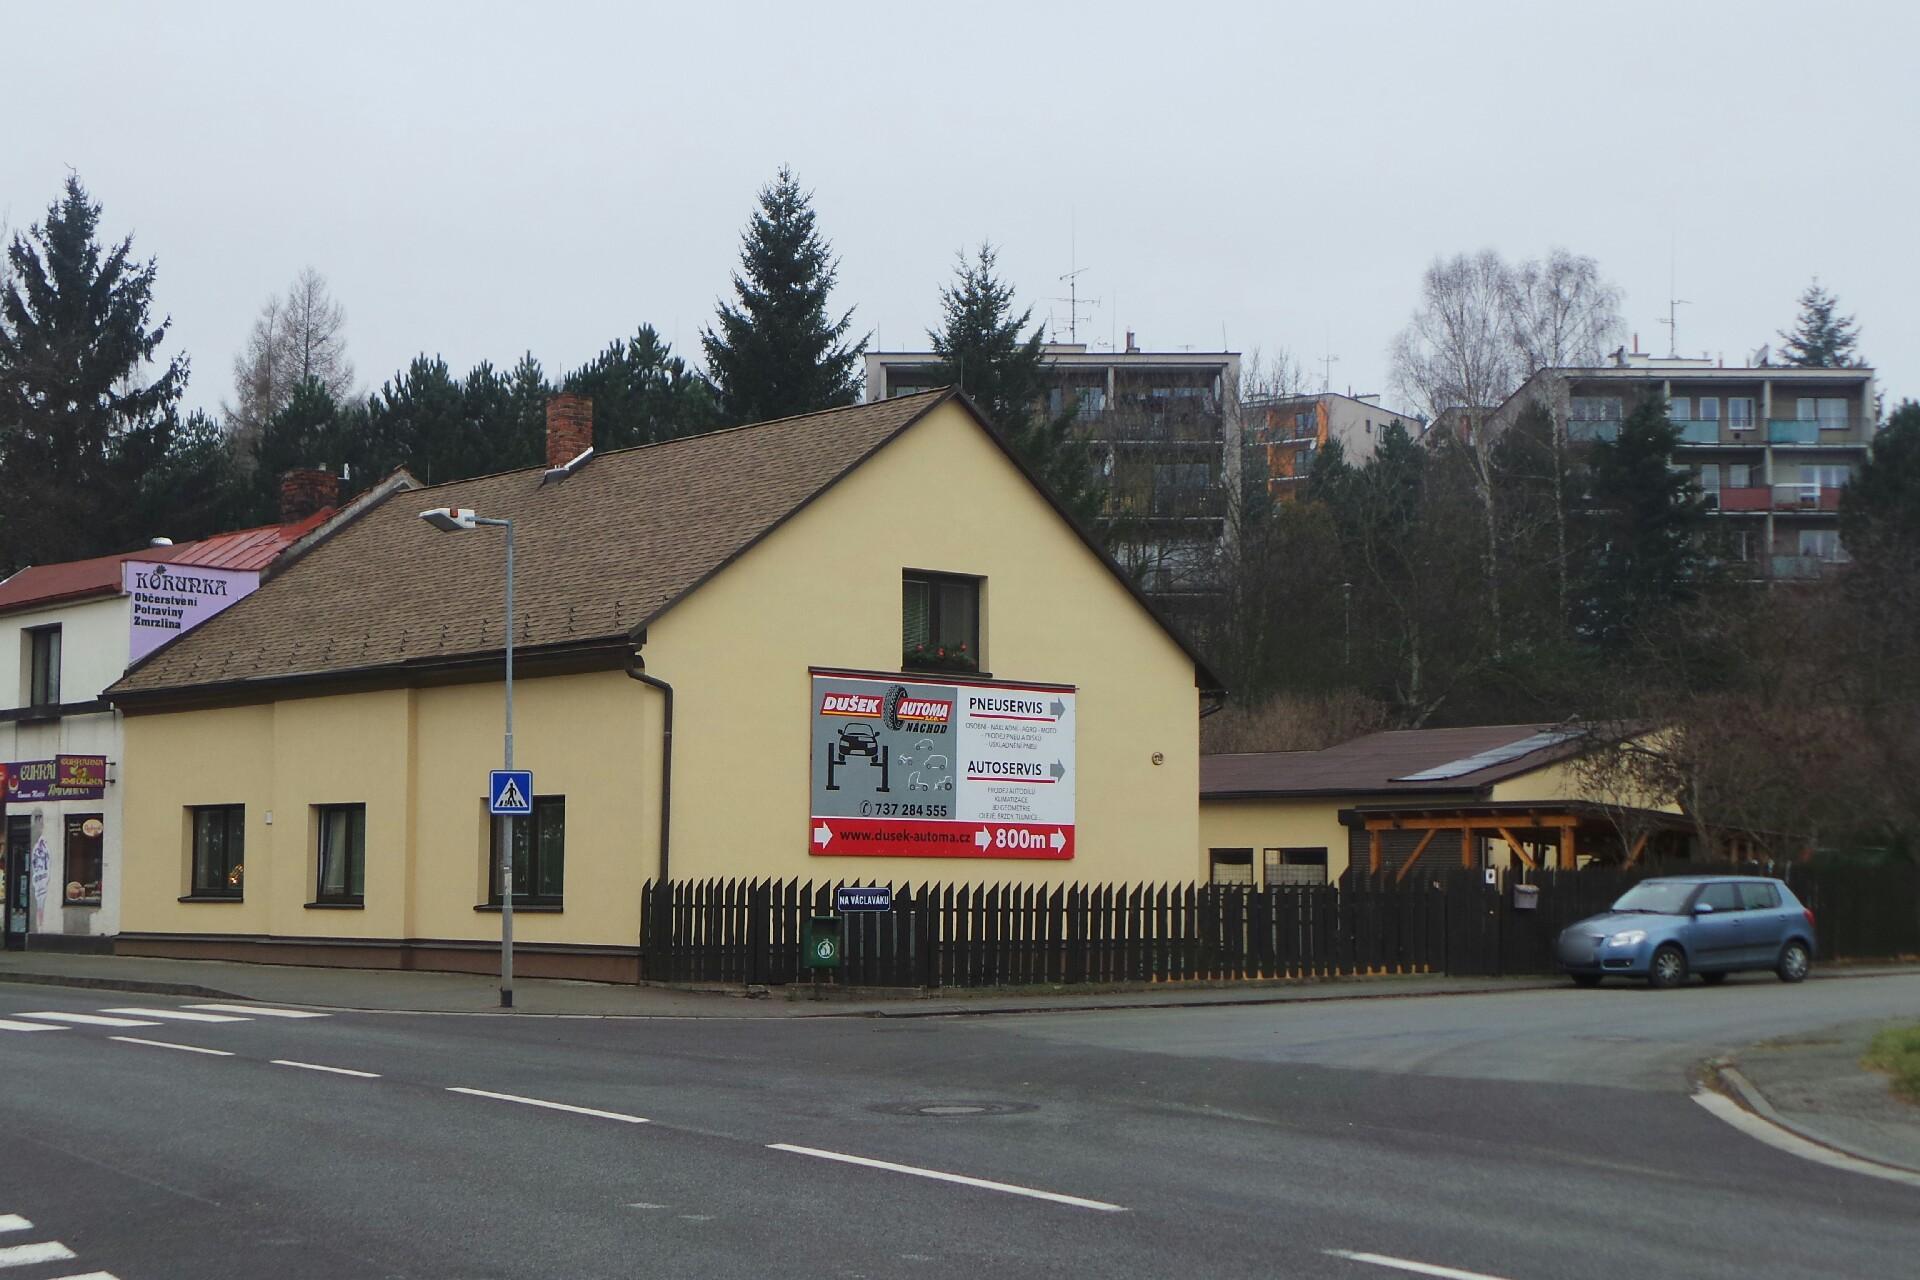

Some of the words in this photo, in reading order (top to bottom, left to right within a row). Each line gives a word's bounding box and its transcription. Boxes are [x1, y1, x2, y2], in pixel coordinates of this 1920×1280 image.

[136, 573, 227, 596] KORUNKA
[134, 604, 184, 619] Potraviny
[134, 616, 181, 629] Zmrzlina
[823, 695, 881, 713] DUŠEK
[899, 701, 948, 717] AUTOMA
[969, 697, 1043, 714] PNEUSERVIS
[906, 722, 948, 734] NÁCHOD
[967, 760, 1042, 776] AUTOSERVIS
[875, 803, 898, 815] 737
[902, 804, 923, 816] 284
[926, 805, 947, 817] 555
[840, 829, 971, 843] www.dusek-automa.cz
[996, 828, 1046, 849] 800m
[839, 895, 849, 905] NA
[851, 894, 889, 905] VÁCLAVÁKU
